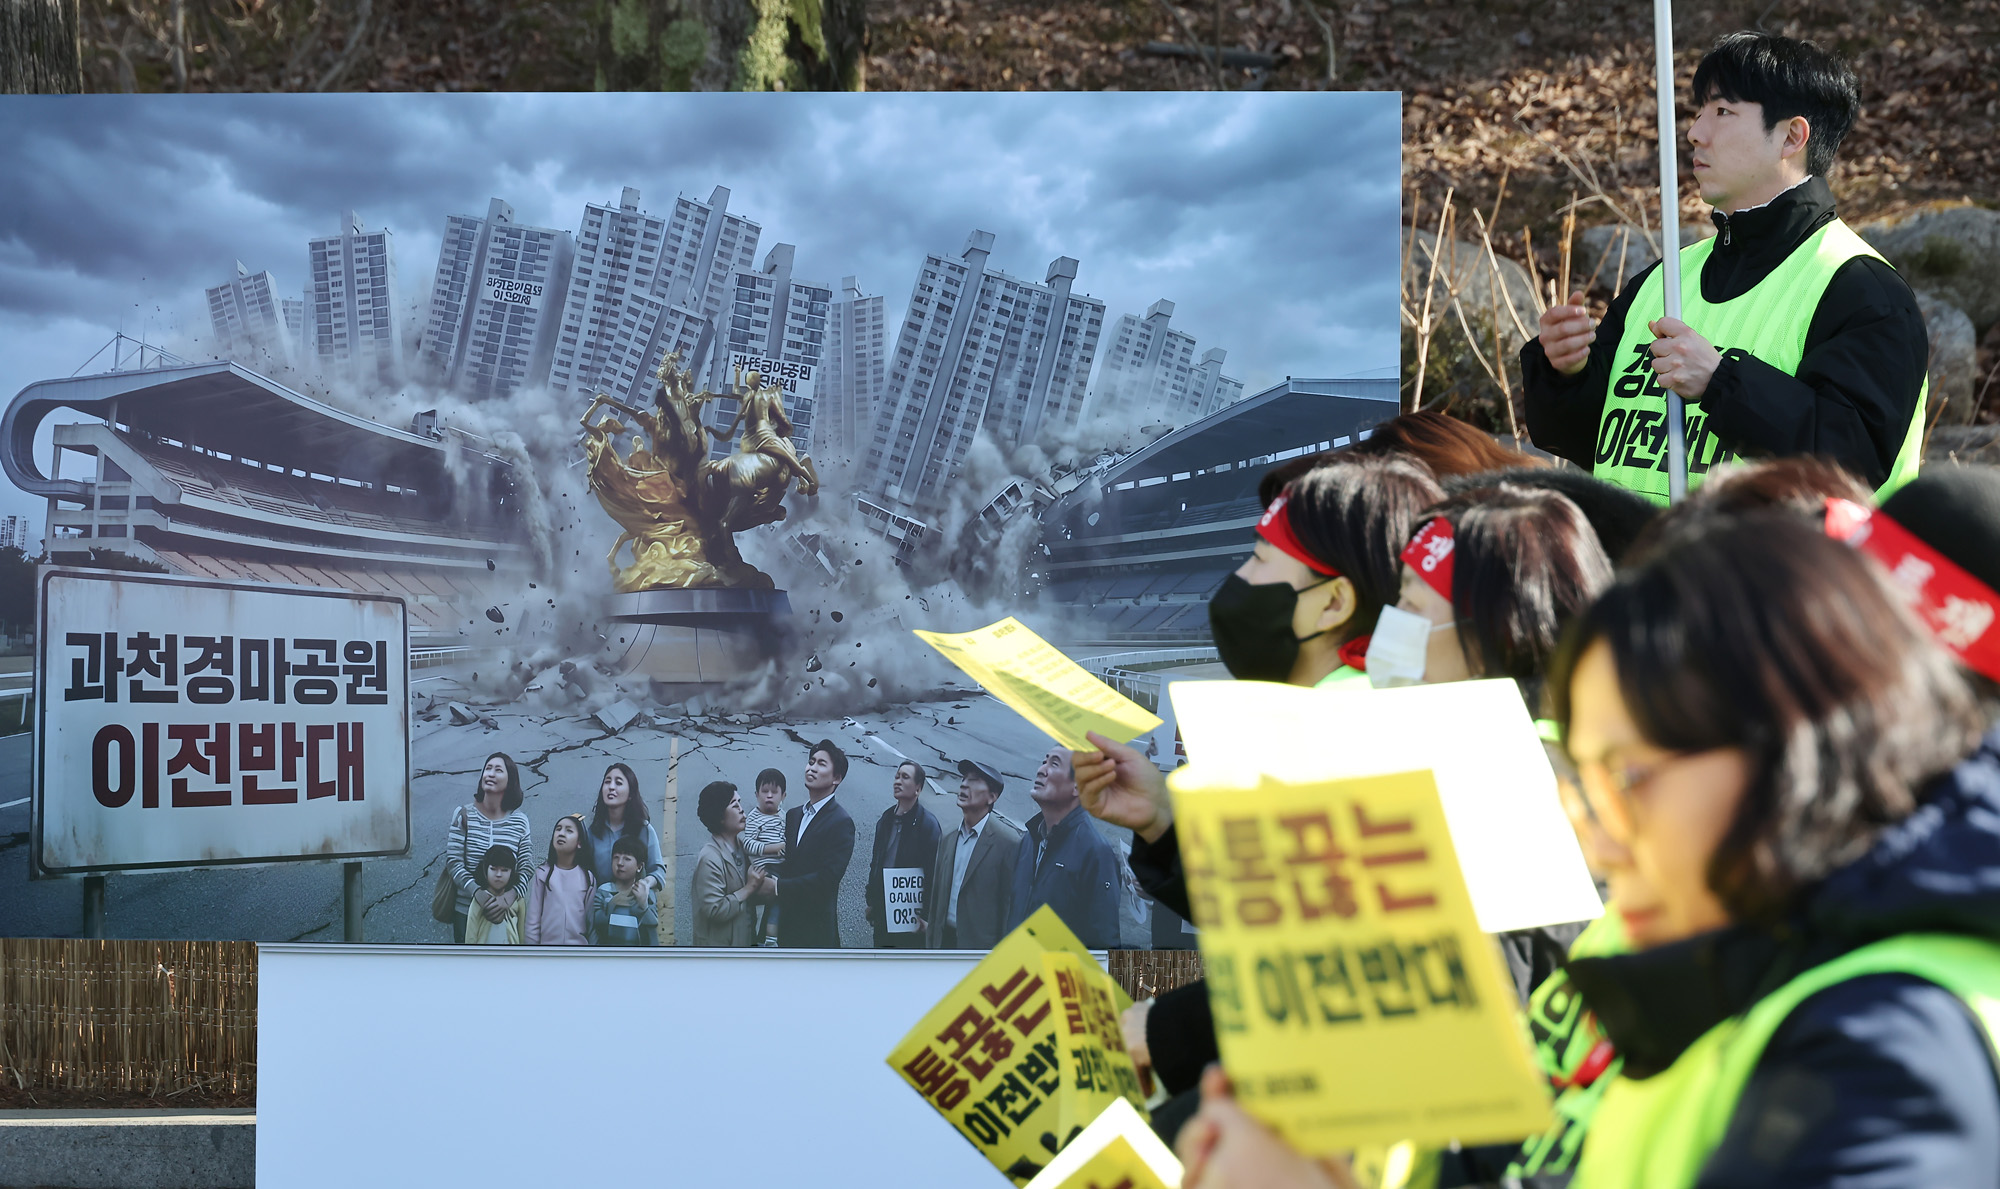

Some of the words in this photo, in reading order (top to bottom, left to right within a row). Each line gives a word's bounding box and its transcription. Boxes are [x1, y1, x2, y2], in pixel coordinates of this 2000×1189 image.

[64, 631, 389, 705] 과천경마공원
[92, 722, 365, 808] 이전반대
[1255, 933, 1482, 1029] 이전반대
[964, 1031, 1060, 1145] 이전반
